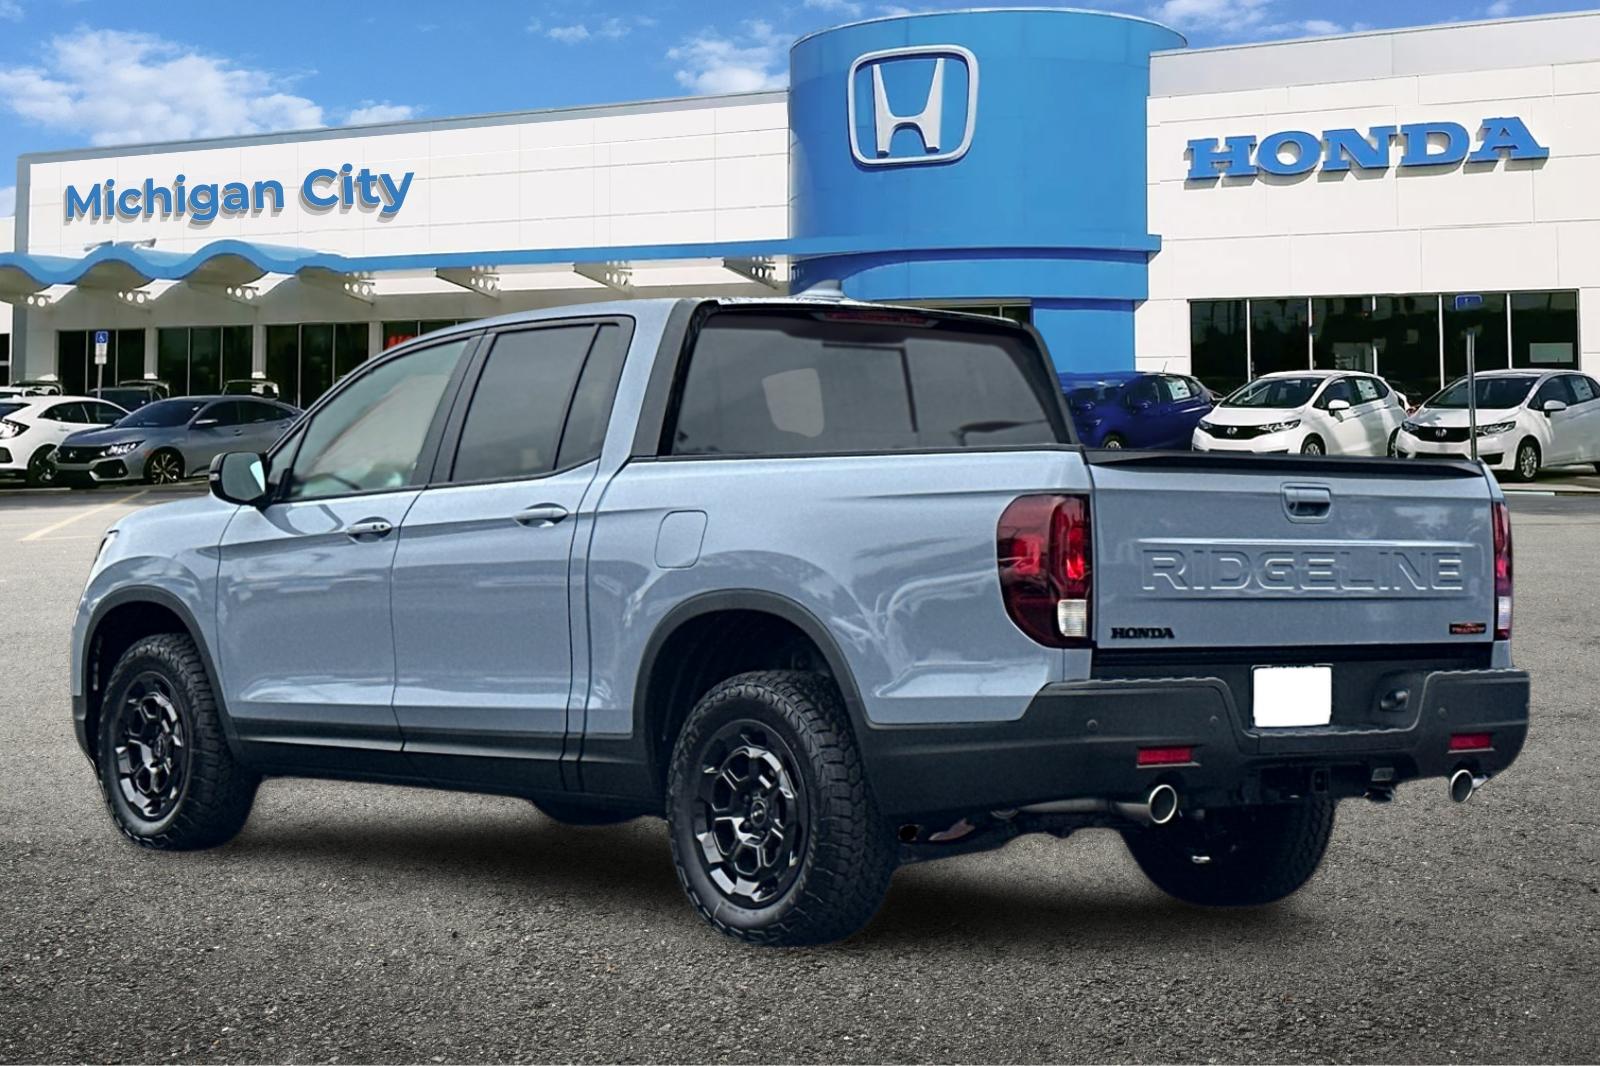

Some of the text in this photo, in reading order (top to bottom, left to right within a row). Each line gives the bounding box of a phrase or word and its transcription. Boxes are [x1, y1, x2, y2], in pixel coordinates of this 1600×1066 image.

[1187, 116, 1550, 181] HONDA
[65, 163, 415, 222] Michigan City
[1142, 549, 1464, 592] RIDGELINE
[1111, 627, 1175, 639] HONDA
